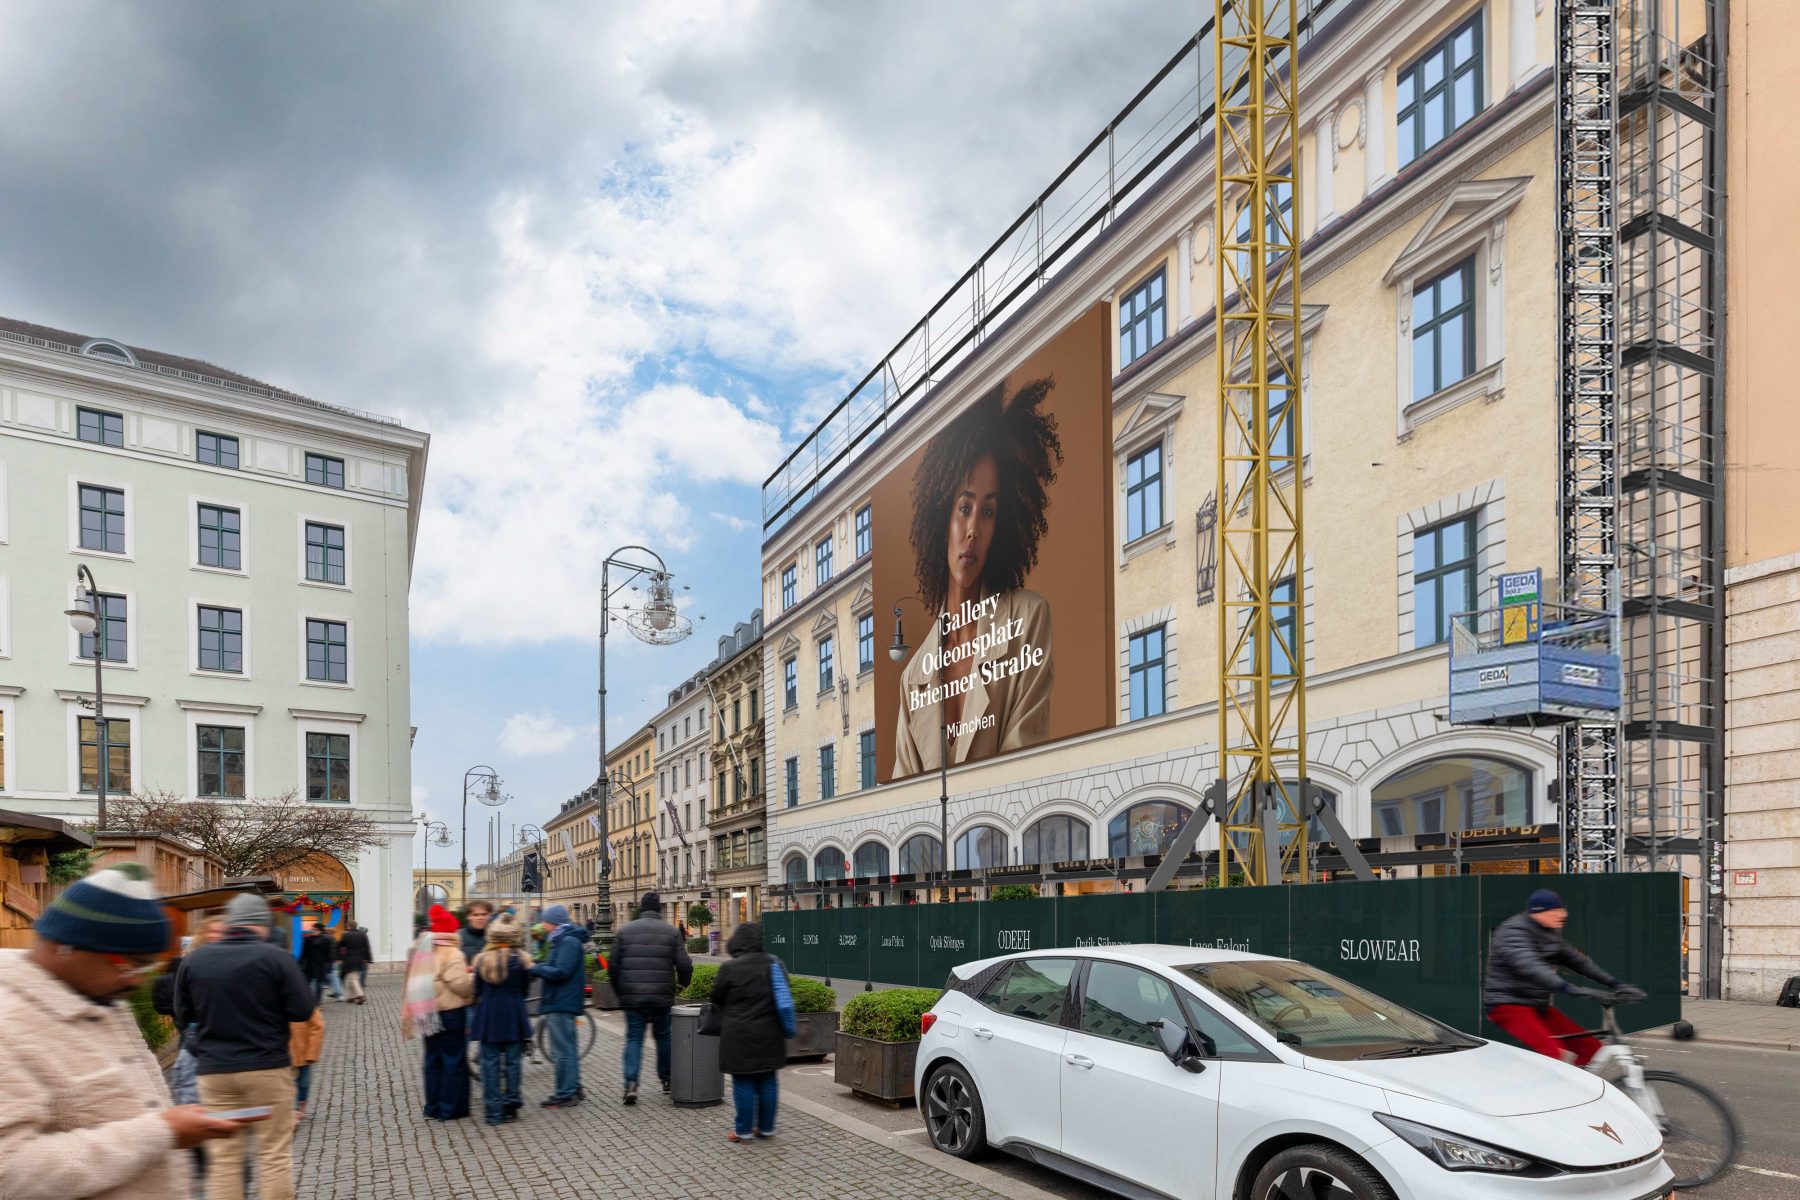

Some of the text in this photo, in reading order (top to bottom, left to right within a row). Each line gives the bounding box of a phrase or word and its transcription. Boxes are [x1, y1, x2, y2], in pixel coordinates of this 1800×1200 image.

[1505, 575, 1535, 588] GEDA
[941, 593, 1000, 635] Gallery
[922, 618, 1024, 675] Odeonsplatz
[910, 643, 1043, 711] Brienner Straße
[1480, 669, 1506, 682] GEDA
[946, 713, 995, 739] München
[998, 930, 1031, 950] ODEEH
[1217, 938, 1249, 952] Faloni
[1340, 939, 1420, 961] SLOWEAR
